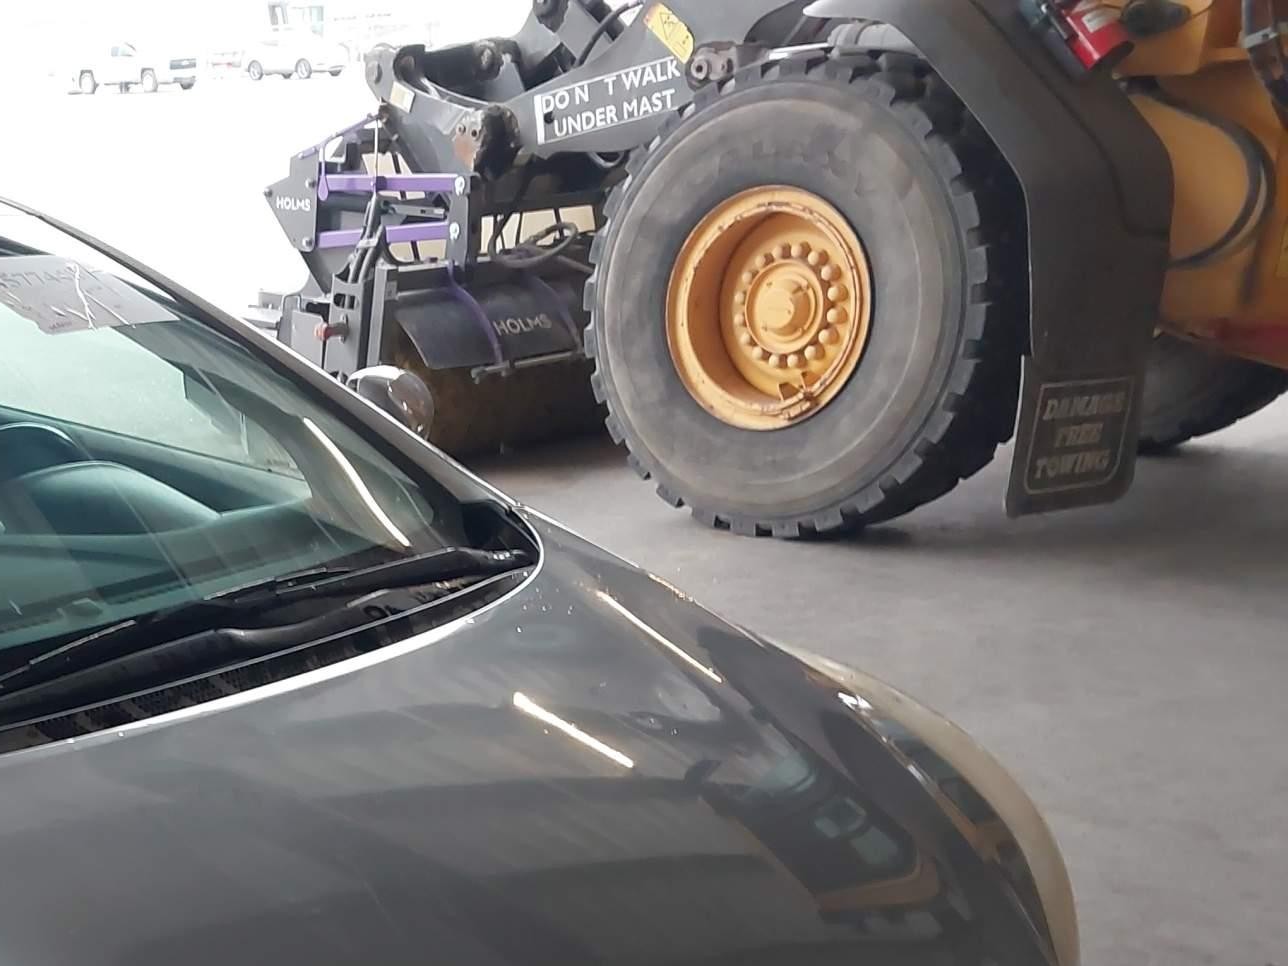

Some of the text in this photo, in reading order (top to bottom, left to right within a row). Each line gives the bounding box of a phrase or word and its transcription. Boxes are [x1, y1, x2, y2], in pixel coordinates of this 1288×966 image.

[621, 60, 680, 90] WALK
[553, 88, 675, 137] UNDER MAST
[276, 195, 311, 211] HOLMS
[493, 313, 552, 336] HOLMS
